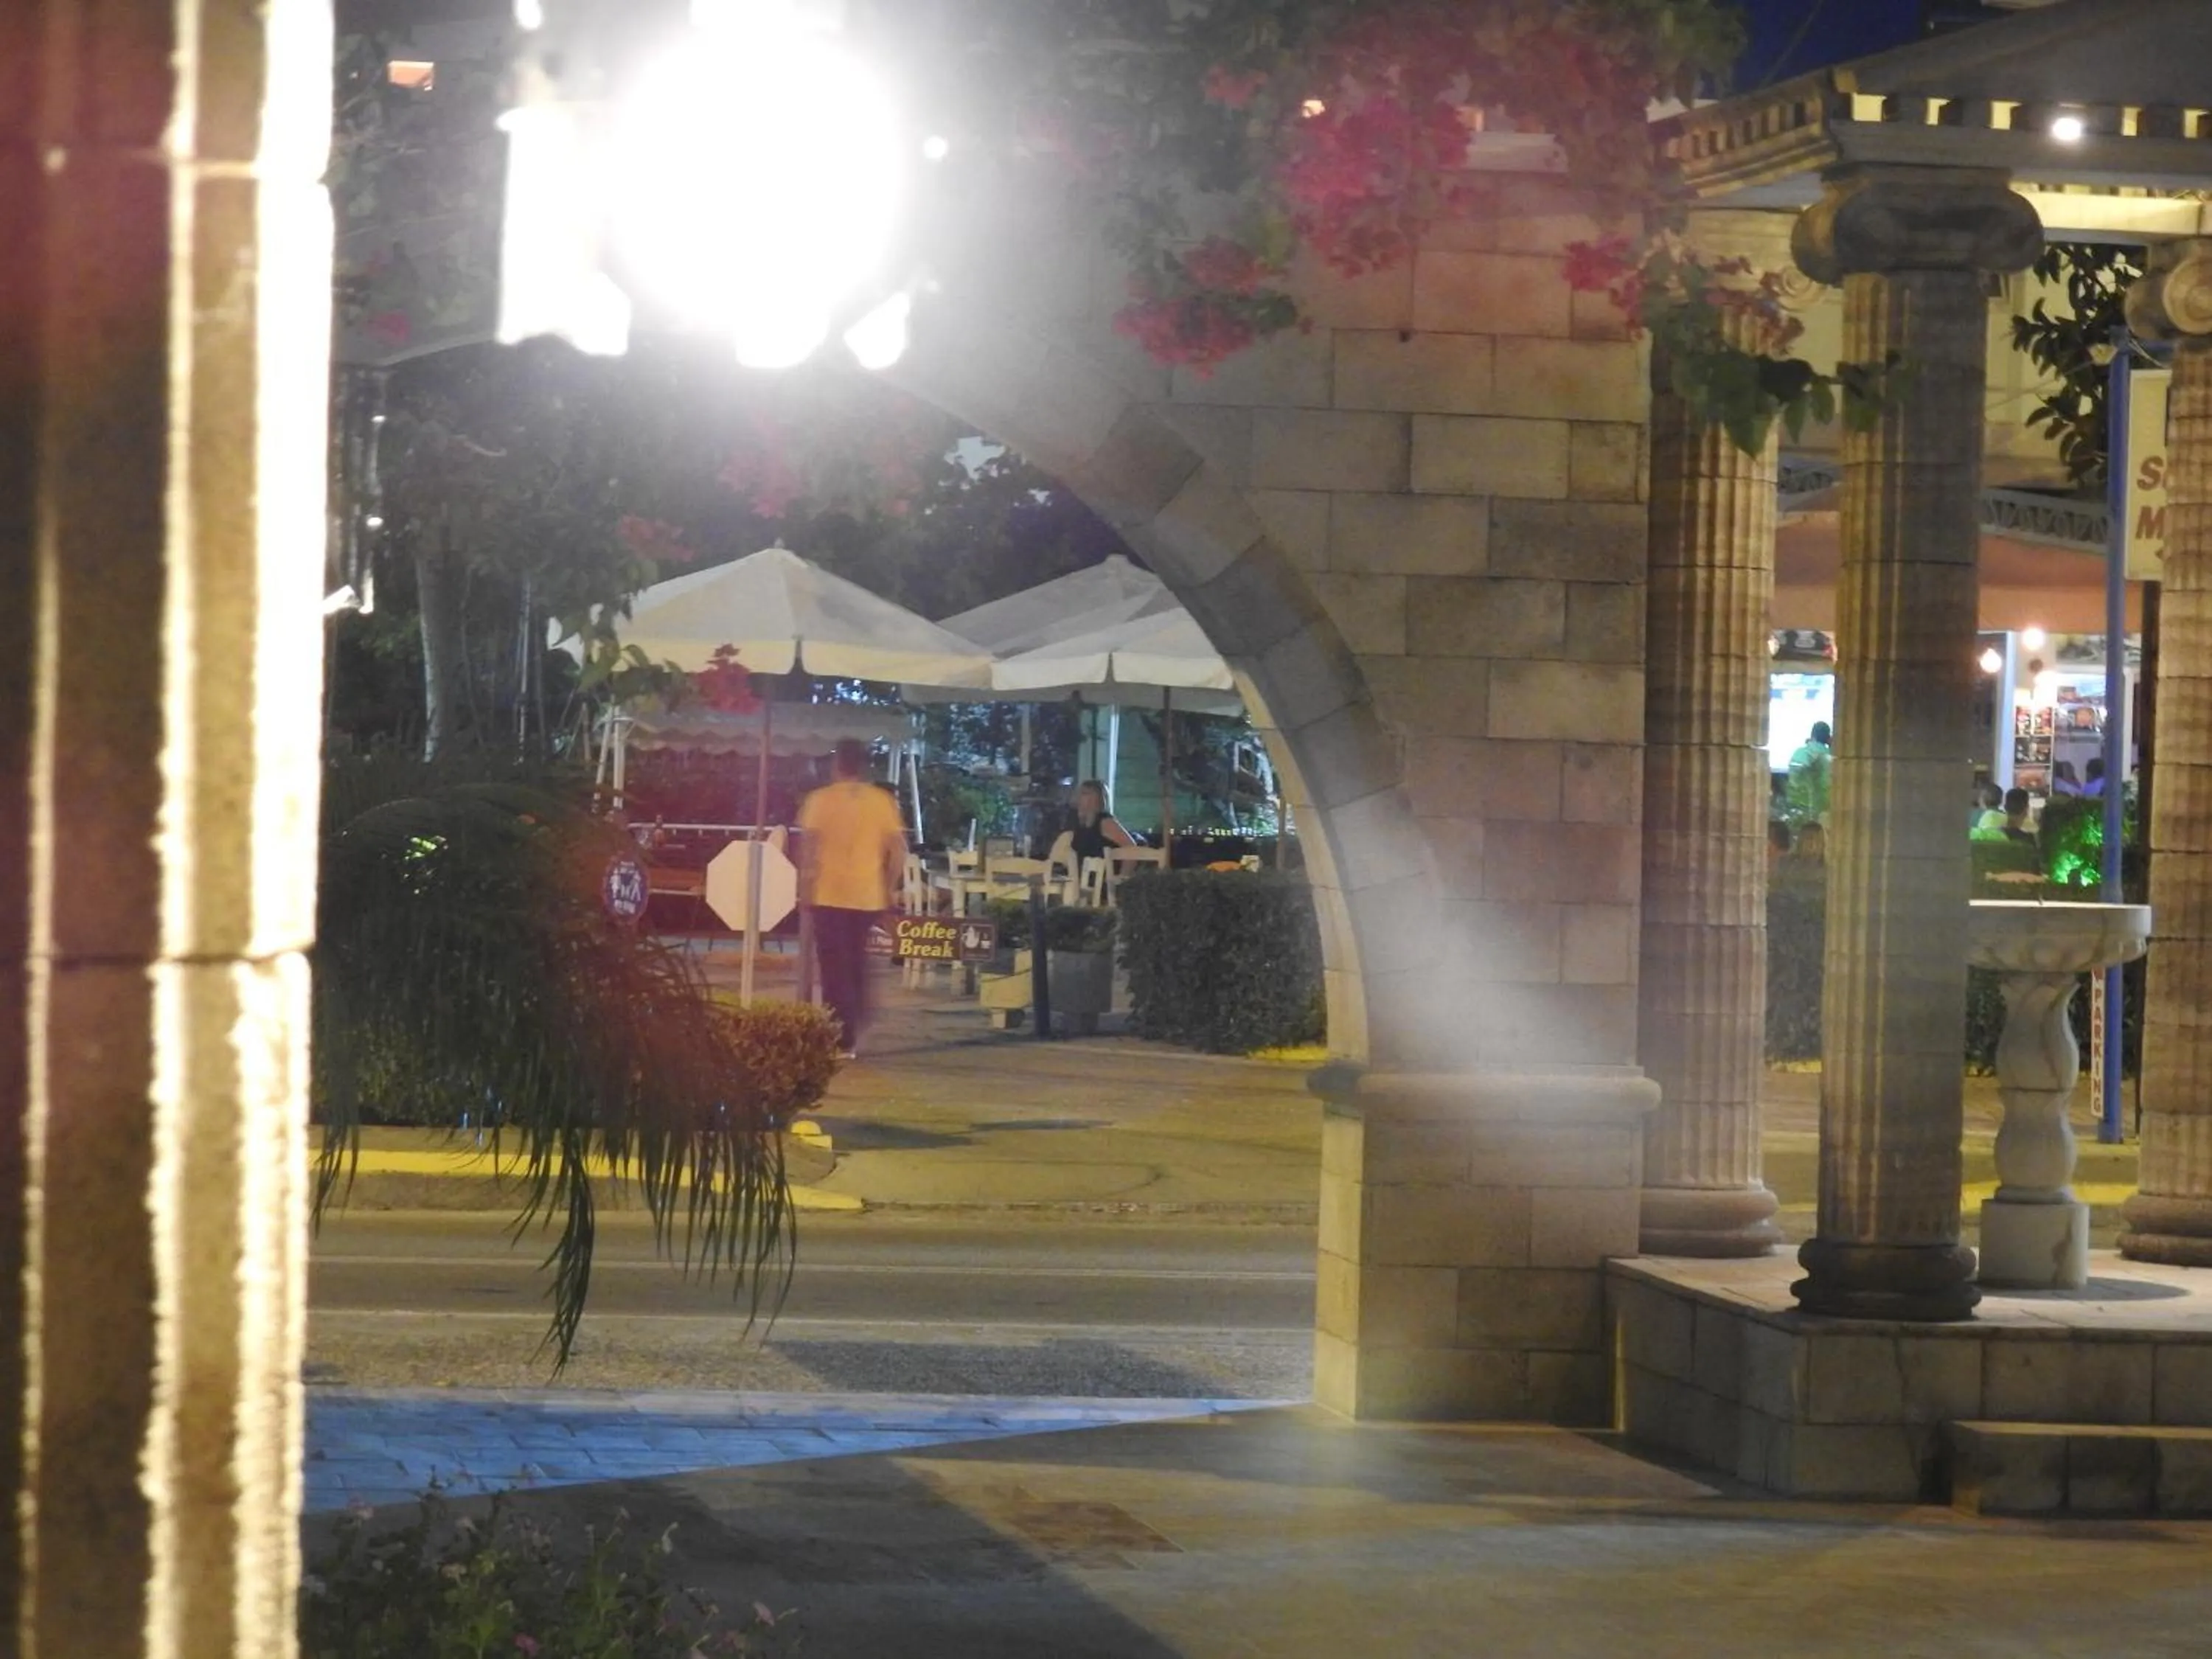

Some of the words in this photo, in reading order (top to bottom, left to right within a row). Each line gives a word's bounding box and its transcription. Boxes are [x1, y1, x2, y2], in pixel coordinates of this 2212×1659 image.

[2136, 456, 2167, 491] S
[897, 920, 956, 939] Coffee
[899, 939, 954, 958] Break
[2093, 988, 2102, 1113] PARKING
